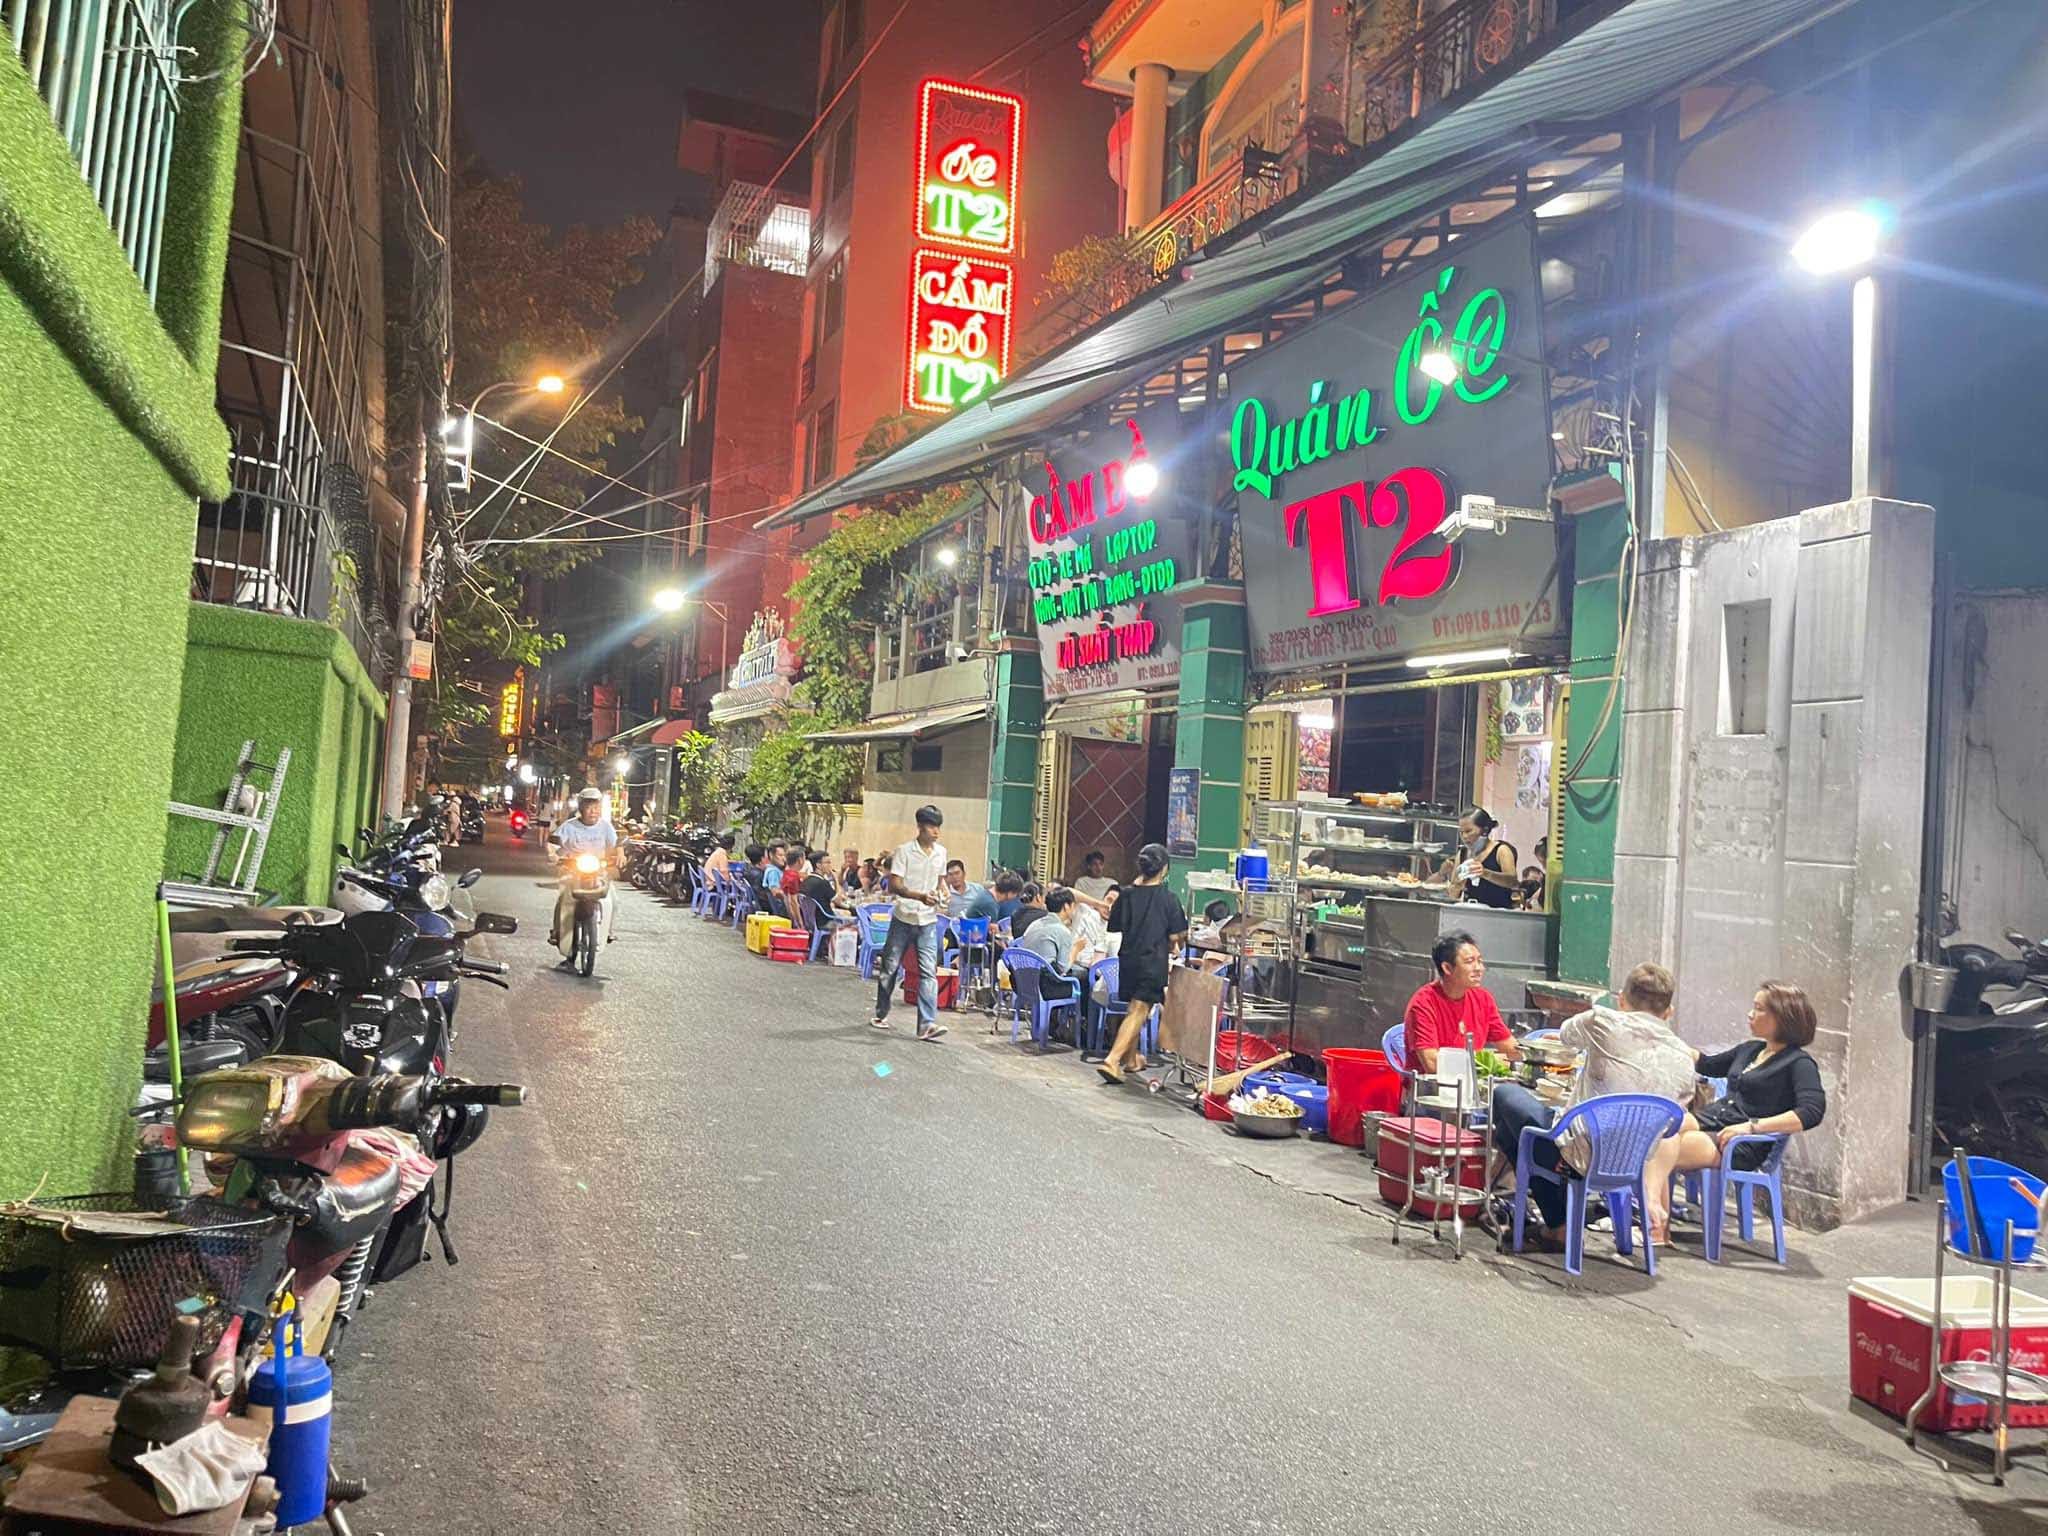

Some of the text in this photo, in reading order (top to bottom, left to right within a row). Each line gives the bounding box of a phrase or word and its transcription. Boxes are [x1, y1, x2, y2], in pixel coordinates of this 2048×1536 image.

[926, 184, 1009, 242] T2
[1231, 380, 1378, 500] Quán
[1283, 466, 1452, 617] T2
